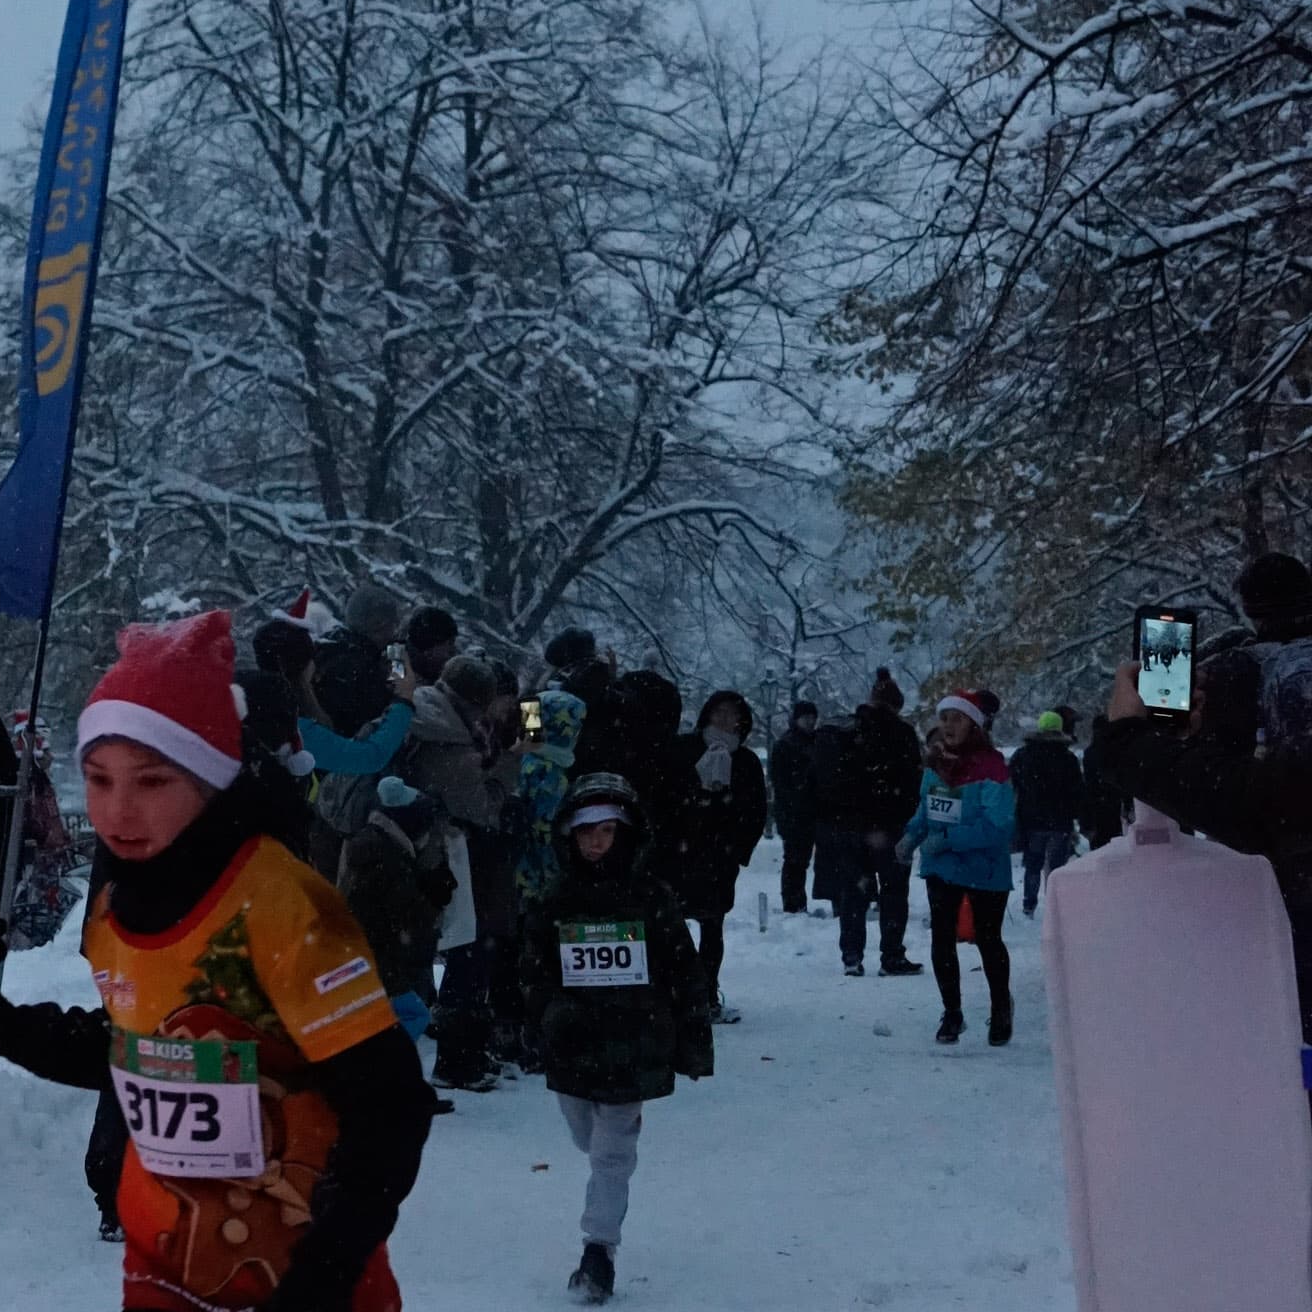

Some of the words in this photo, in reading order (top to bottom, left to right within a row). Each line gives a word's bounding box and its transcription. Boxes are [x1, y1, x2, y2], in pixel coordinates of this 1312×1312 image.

[930, 798, 953, 813] 3217
[572, 945, 632, 970] 3190
[154, 1041, 195, 1060] KIDS
[125, 1081, 220, 1142] 3173
